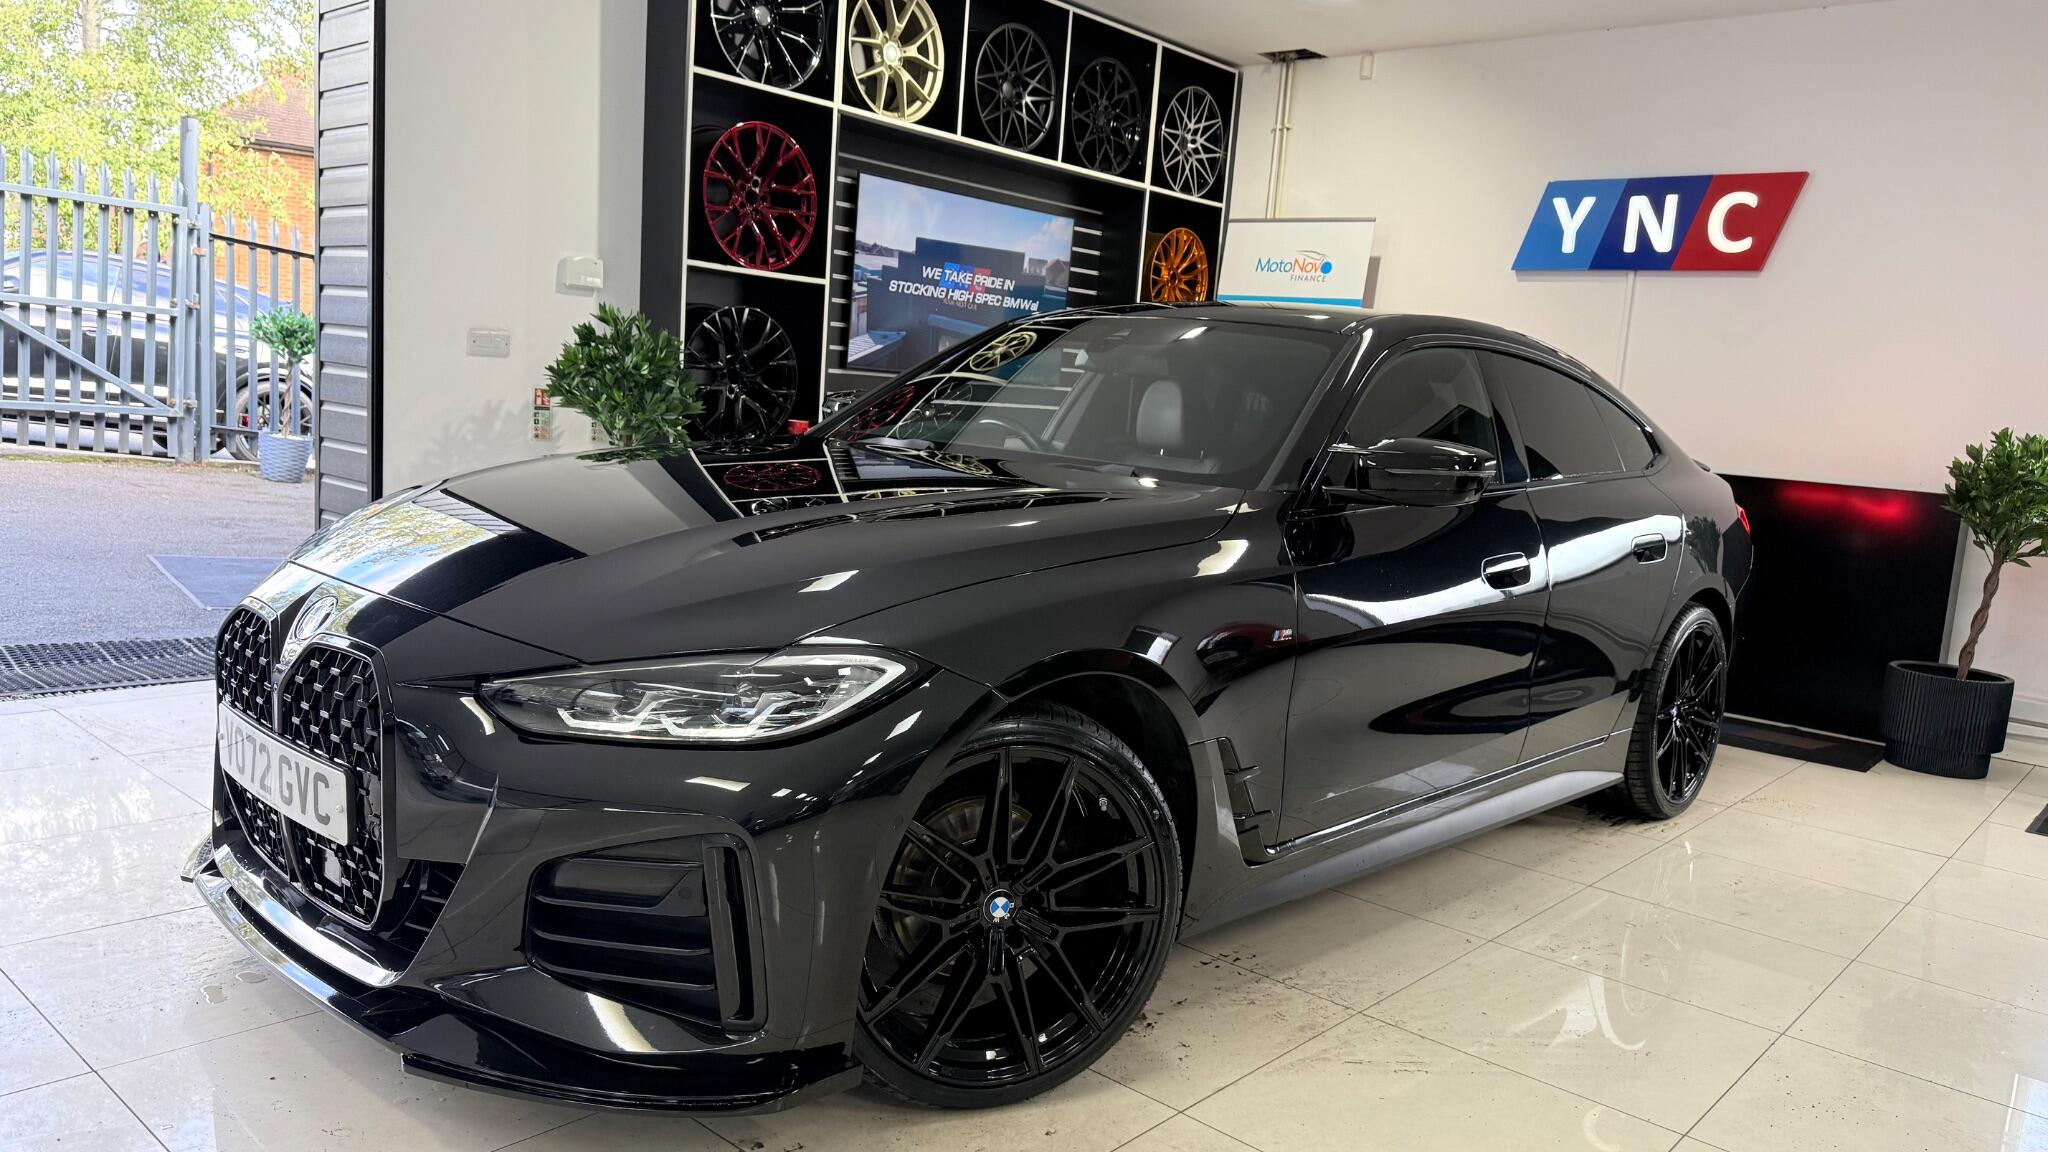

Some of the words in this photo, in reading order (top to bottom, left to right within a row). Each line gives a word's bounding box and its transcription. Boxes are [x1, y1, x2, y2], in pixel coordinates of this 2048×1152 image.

[1552, 191, 1758, 254] YNC
[922, 265, 942, 280] WE
[944, 269, 973, 285] TAKE
[973, 274, 1003, 291] PRIDE
[1003, 279, 1015, 292] IN
[1289, 274, 1326, 283] FINANCE
[889, 279, 946, 299] STOCKING
[947, 288, 974, 303] HIGH
[975, 292, 1002, 307] SPEC
[278, 753, 331, 826] GVC
